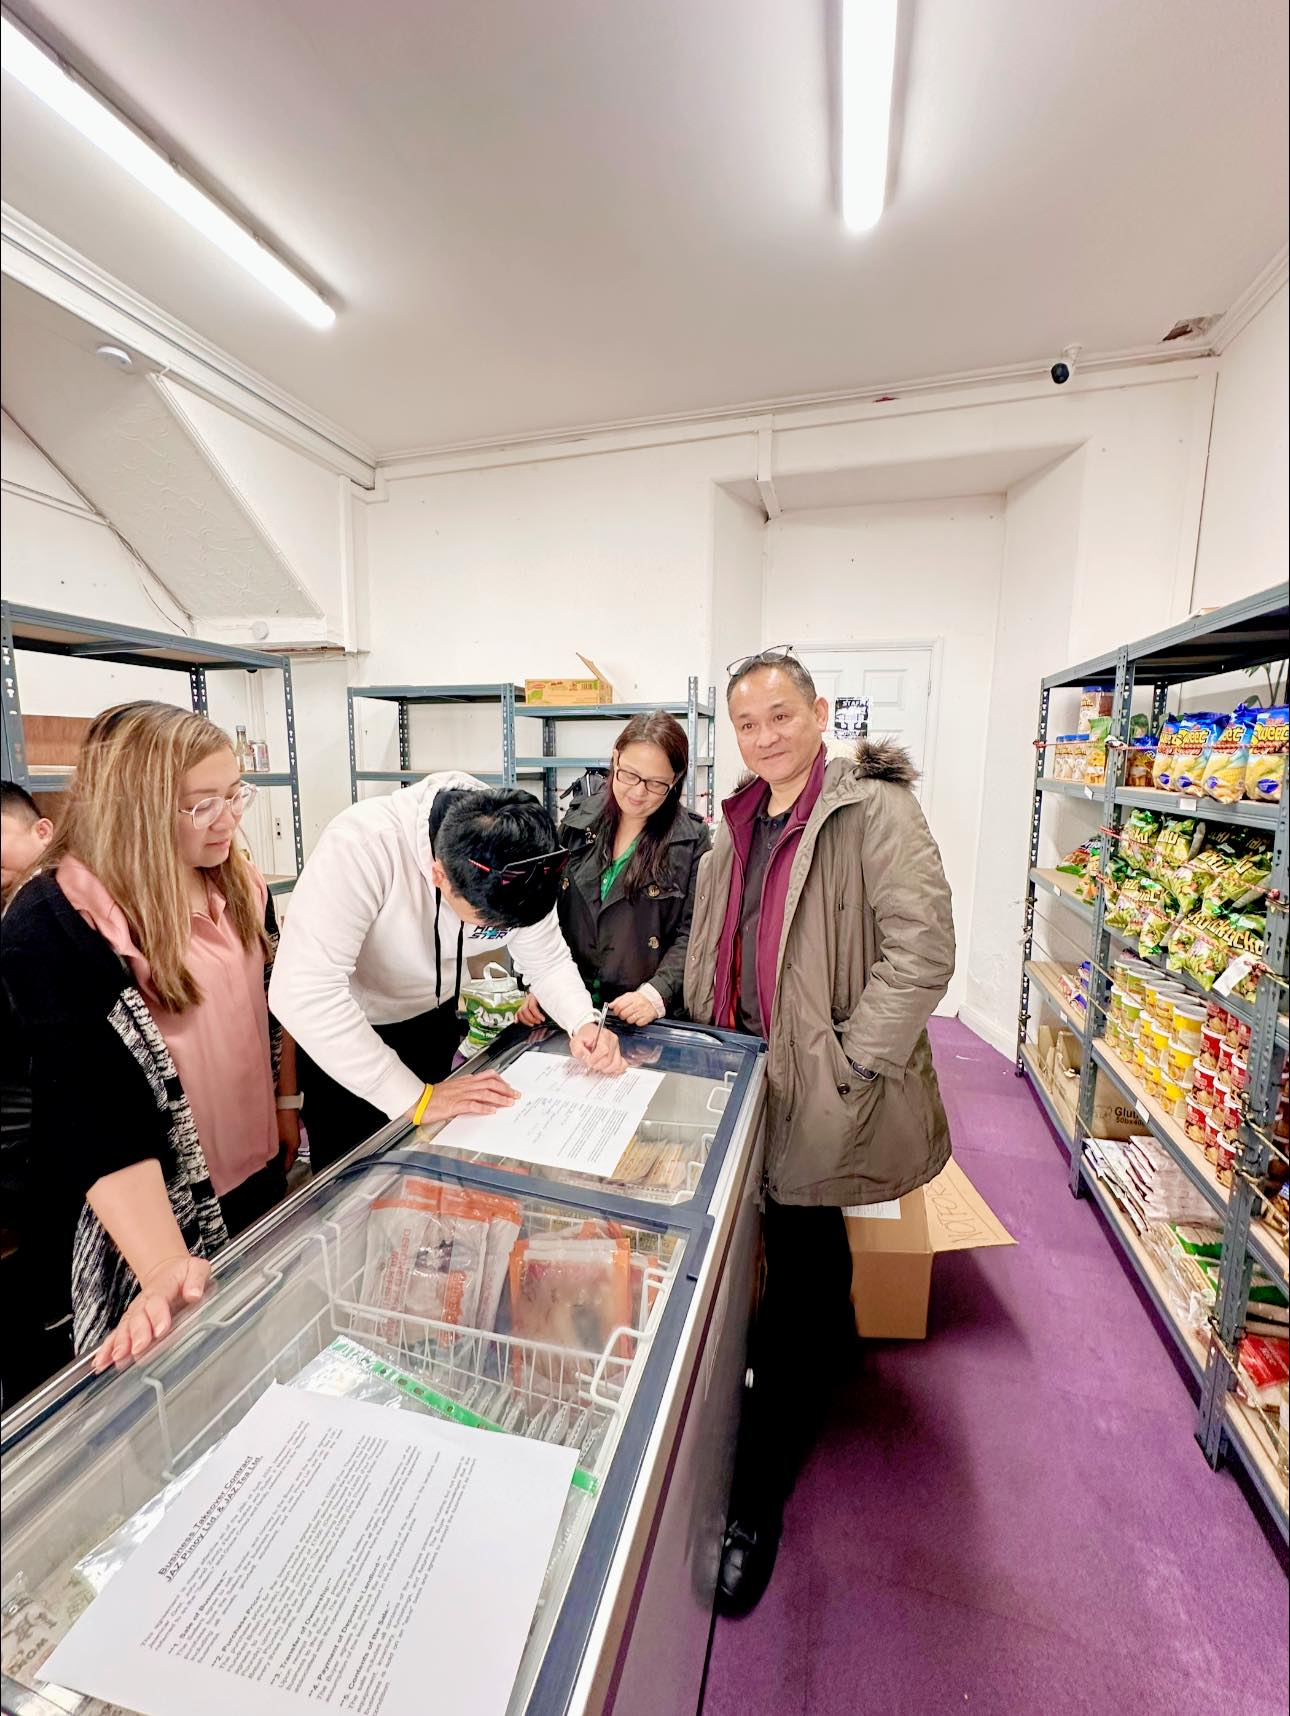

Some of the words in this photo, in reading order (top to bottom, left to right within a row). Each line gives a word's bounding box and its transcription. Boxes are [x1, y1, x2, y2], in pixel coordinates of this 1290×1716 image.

[156, 1530, 197, 1577] Business
[191, 1489, 227, 1530] Takeover
[222, 1454, 253, 1489] Contract
[162, 1561, 184, 1583] JAZ
[179, 1532, 205, 1560] Pinoy
[214, 1504, 226, 1513] &
[220, 1486, 240, 1504] JAZ
[234, 1470, 251, 1486] Tea
[245, 1454, 263, 1470] Ltd.
